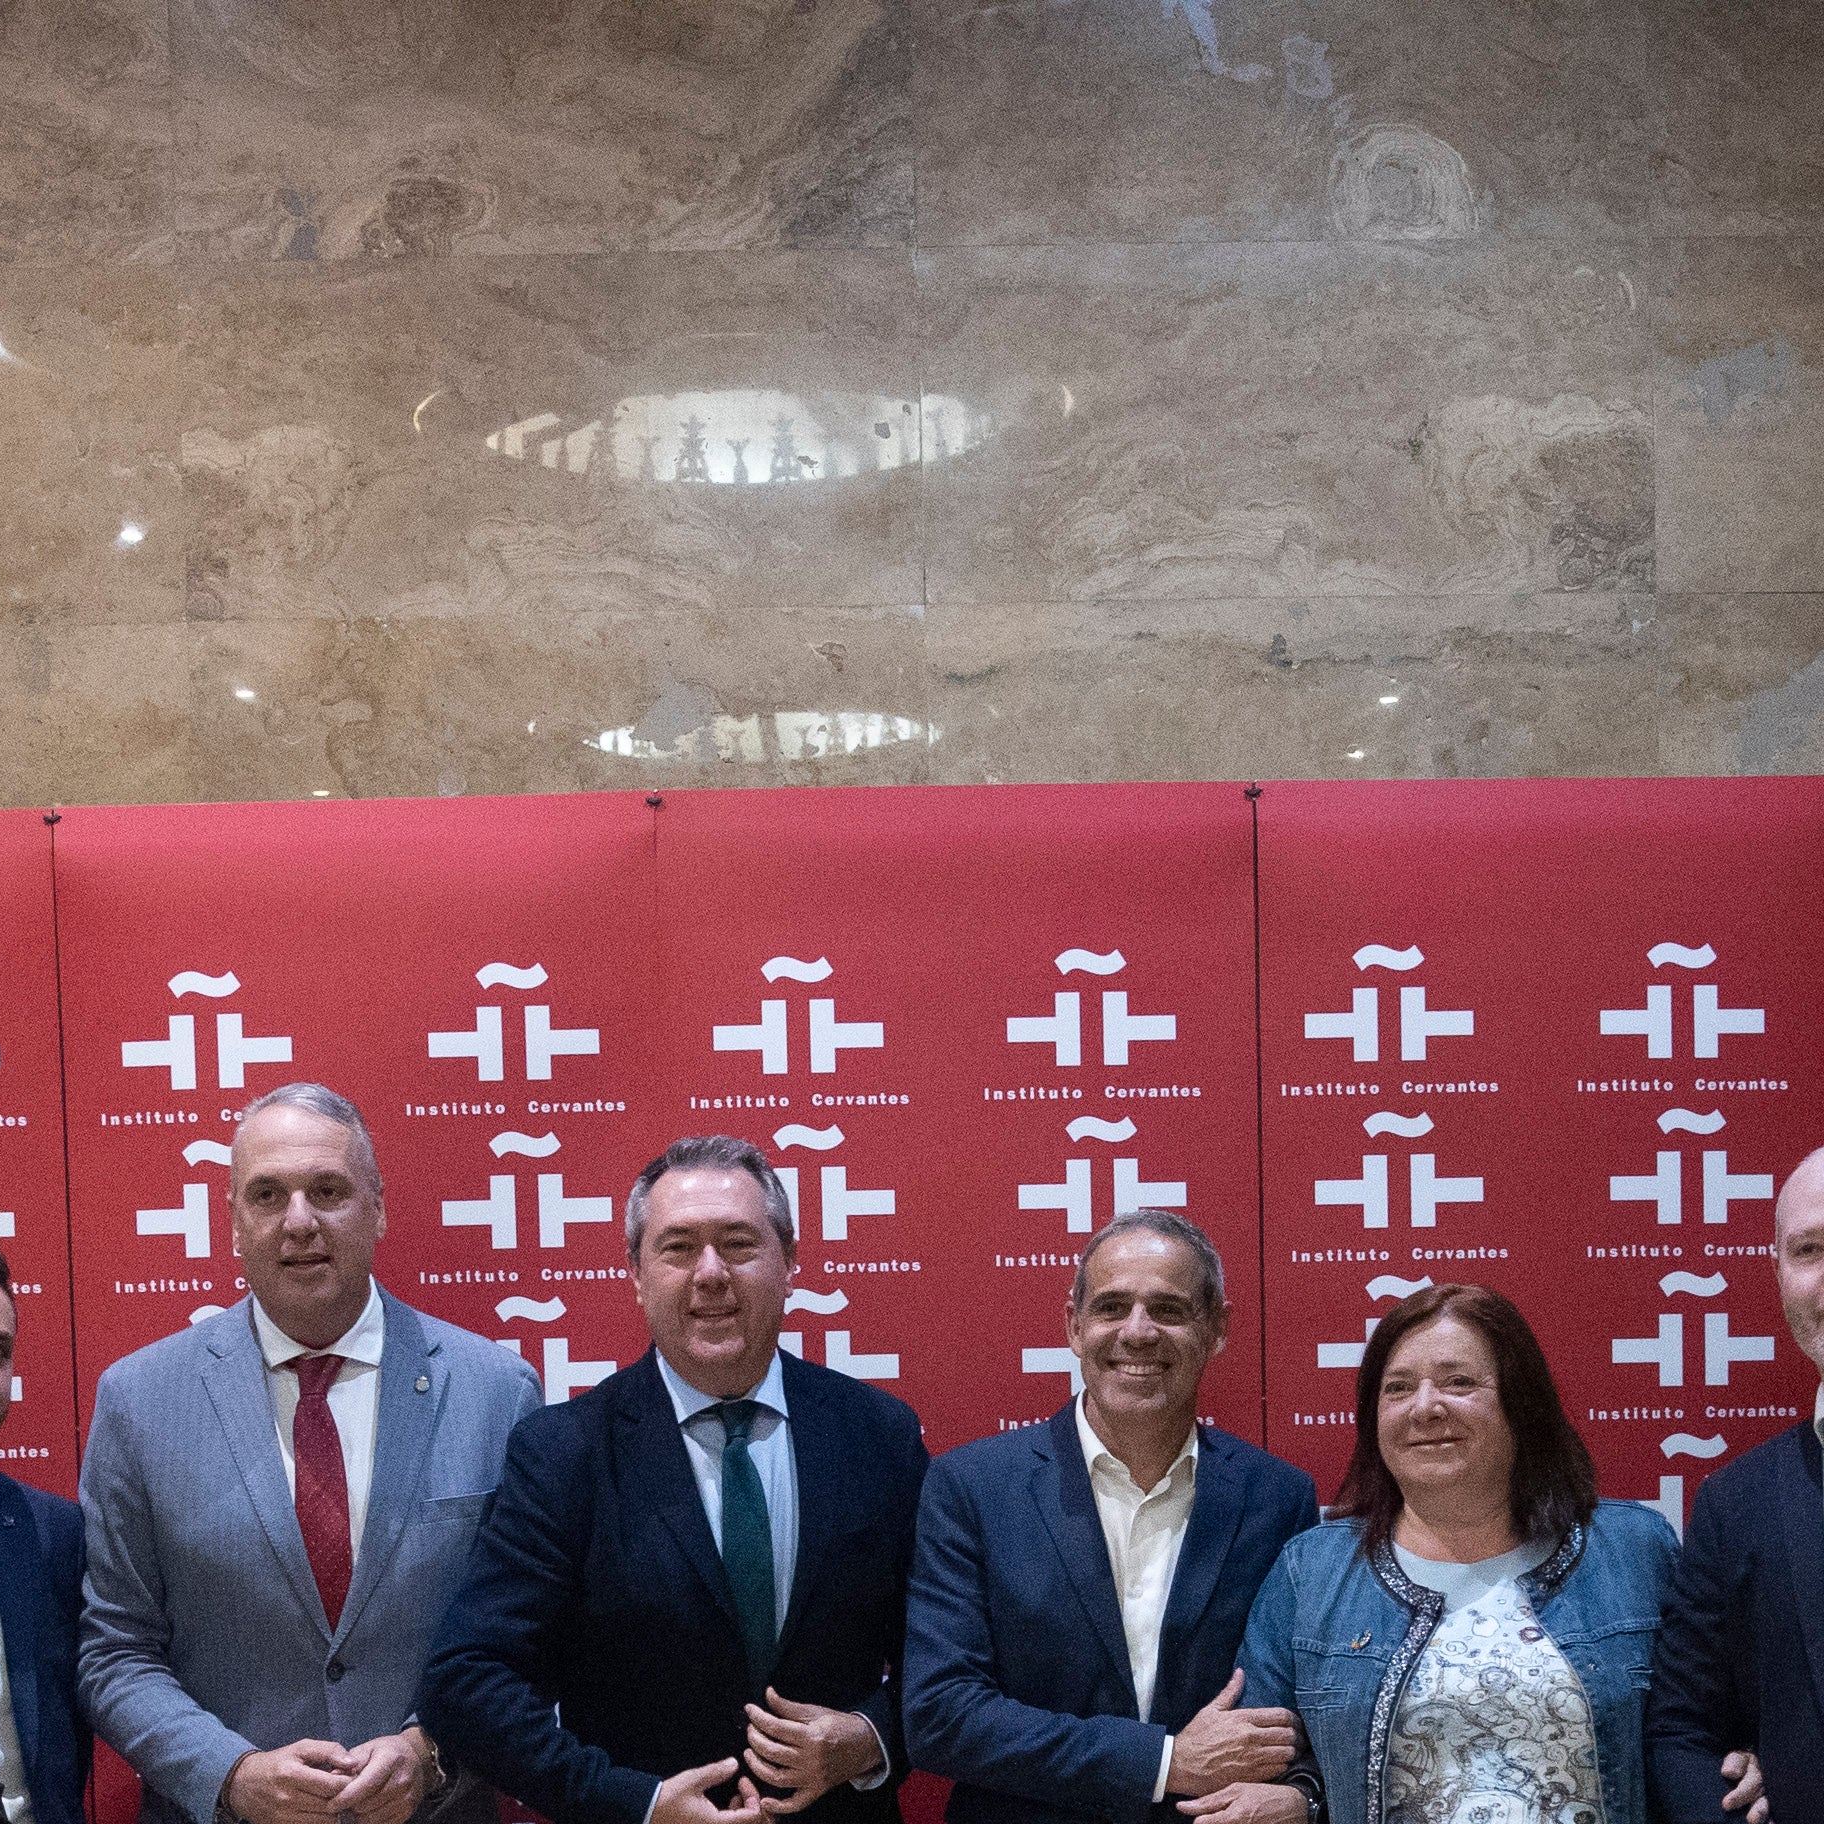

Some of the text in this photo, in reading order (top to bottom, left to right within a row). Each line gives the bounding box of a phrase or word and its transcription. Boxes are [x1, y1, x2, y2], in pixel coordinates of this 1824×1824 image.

[984, 1084, 1201, 1101] Instituto Cervantes
[1281, 1080, 1499, 1097] Instituto Cervantes
[1577, 1078, 1788, 1092] Instituto Cervantes
[406, 1099, 626, 1116] Instituto Cervantes
[690, 1092, 910, 1109] Instituto Cervantes
[101, 1110, 199, 1126] Instituto
[1291, 1246, 1509, 1263] Instituto Cervantes
[1587, 1243, 1777, 1258] Instituto Cervant
[823, 1259, 921, 1274] Cervantes
[995, 1253, 1081, 1268] Institut
[419, 1266, 627, 1284] Instituto Cervante
[115, 1278, 213, 1294] Instituto
[1294, 1411, 1356, 1426] Instit
[1588, 1404, 1798, 1421] Instituto Cervantes
